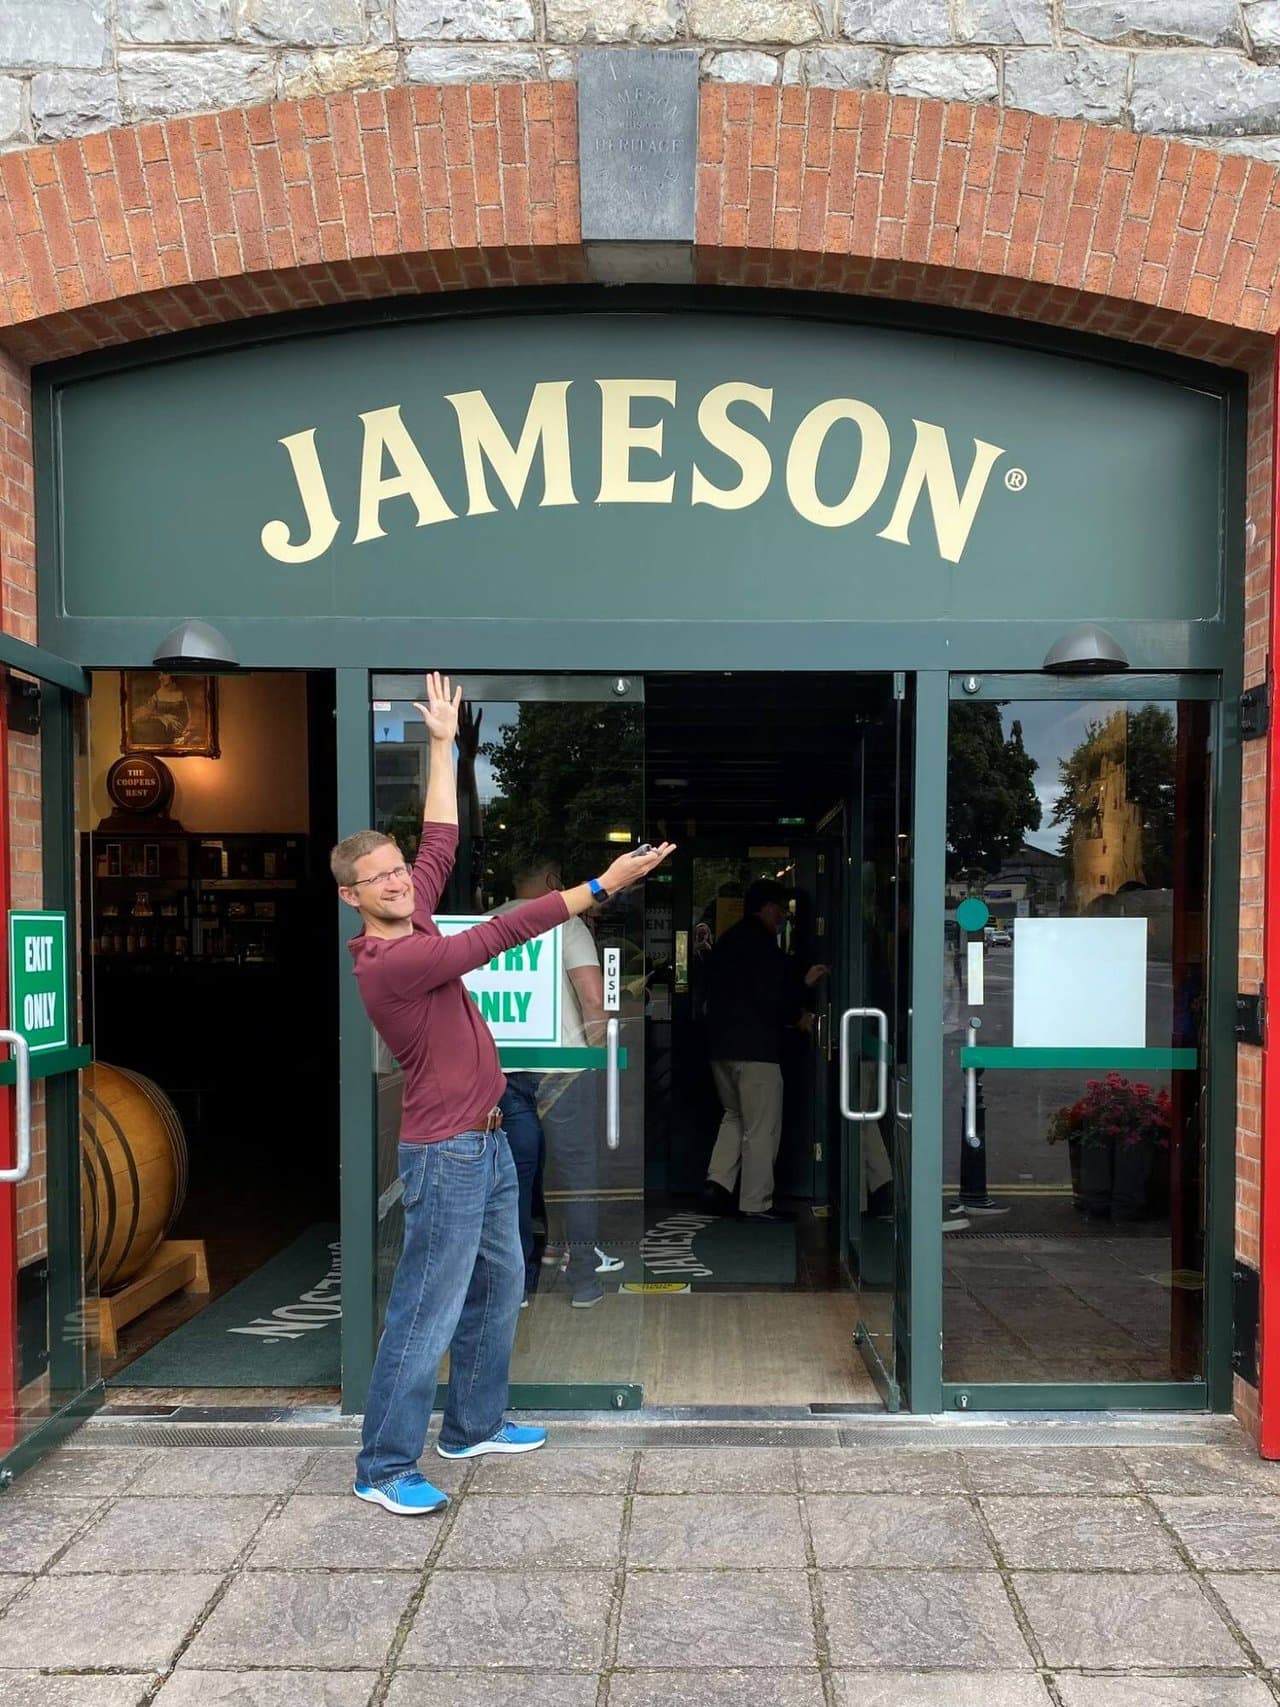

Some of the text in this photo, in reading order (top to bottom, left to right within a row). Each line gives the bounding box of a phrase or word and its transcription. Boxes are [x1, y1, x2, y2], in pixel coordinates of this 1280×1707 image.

[595, 138, 684, 153] HERITAGE
[117, 778, 155, 786] COOPERS
[126, 789, 148, 797] REST
[25, 936, 53, 972] EXIT
[608, 954, 616, 1004] PUSH
[24, 992, 56, 1031] ONLY
[640, 1213, 721, 1277] JAMESON
